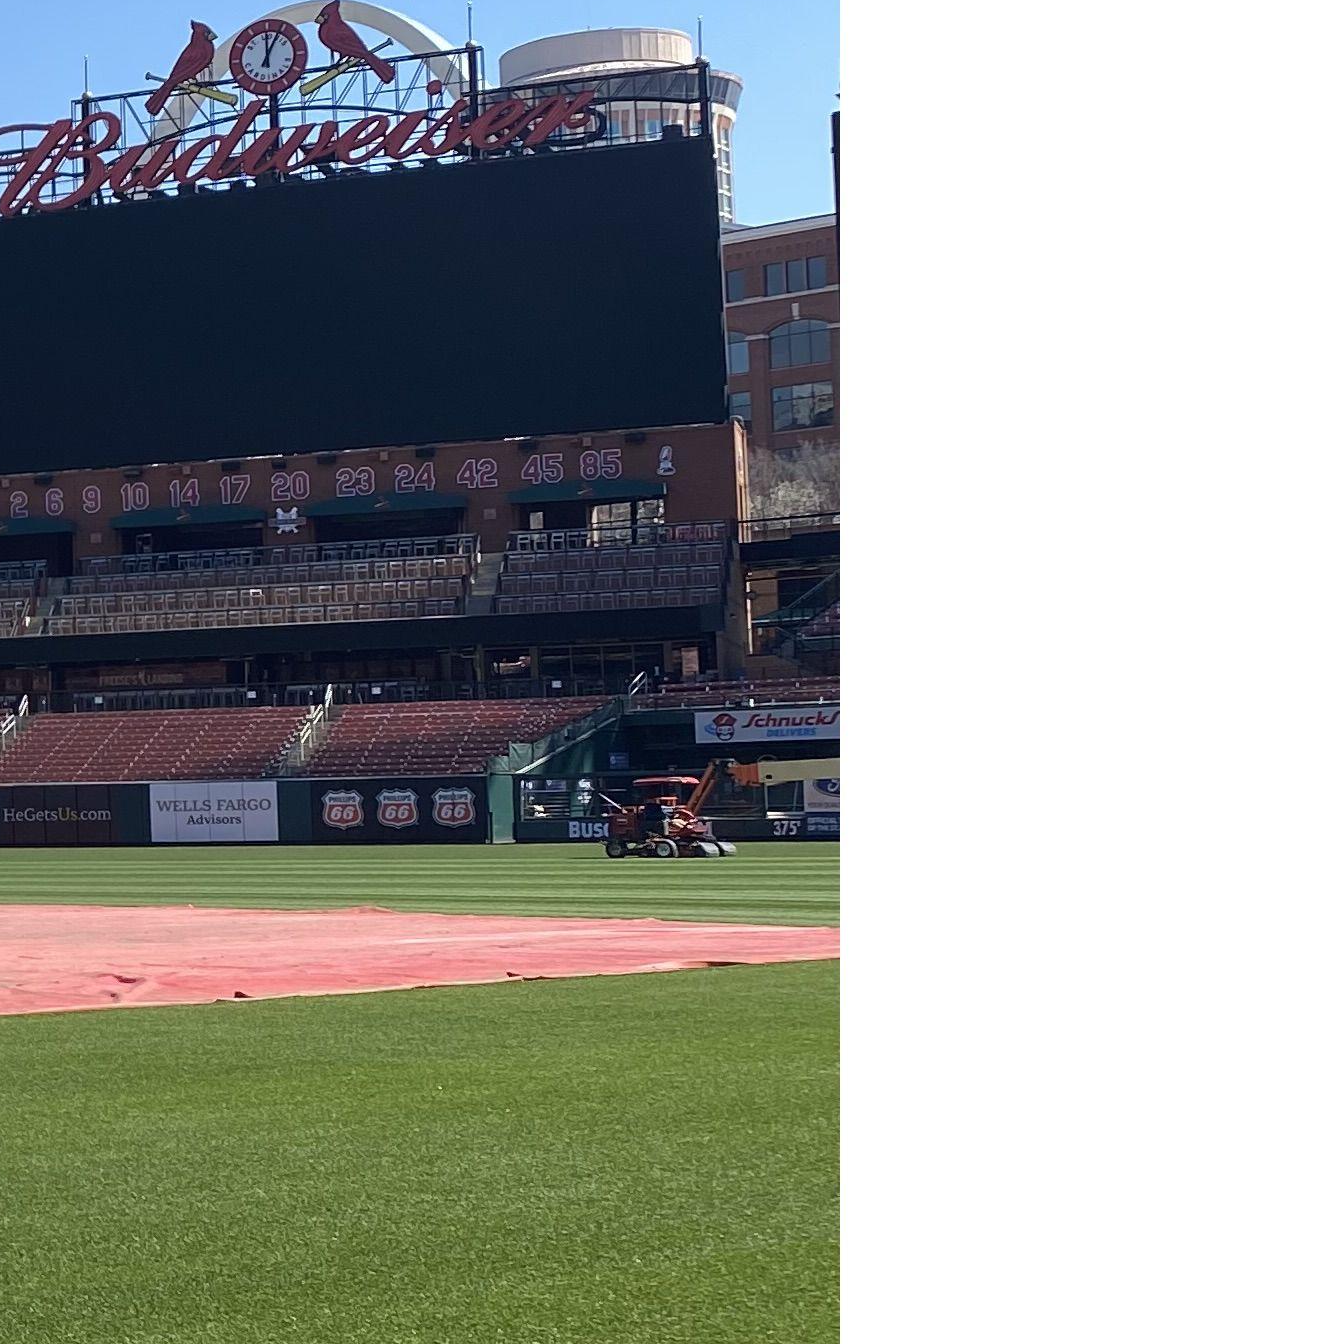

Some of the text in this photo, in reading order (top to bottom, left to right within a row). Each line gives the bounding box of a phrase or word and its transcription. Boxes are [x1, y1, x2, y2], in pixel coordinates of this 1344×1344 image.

[245, 58, 291, 80] CARDINALS
[10, 491, 28, 519] 2
[45, 488, 63, 516] 6
[83, 486, 101, 513] 9
[121, 482, 149, 511] 10
[169, 478, 200, 507] 14
[219, 475, 251, 504] 17
[271, 471, 310, 501] 20
[336, 467, 375, 497] 23
[394, 462, 435, 493] 24
[456, 458, 499, 489] 42
[521, 453, 564, 484] 45
[580, 449, 623, 480] 85
[766, 727, 817, 737] DELIVERS
[156, 798, 272, 813] WELLS FARGO
[330, 806, 355, 820] 66
[385, 805, 414, 819] 66
[440, 804, 467, 819] 66
[3, 807, 111, 822] HeGetsUs.com
[186, 814, 242, 825] Advisors
